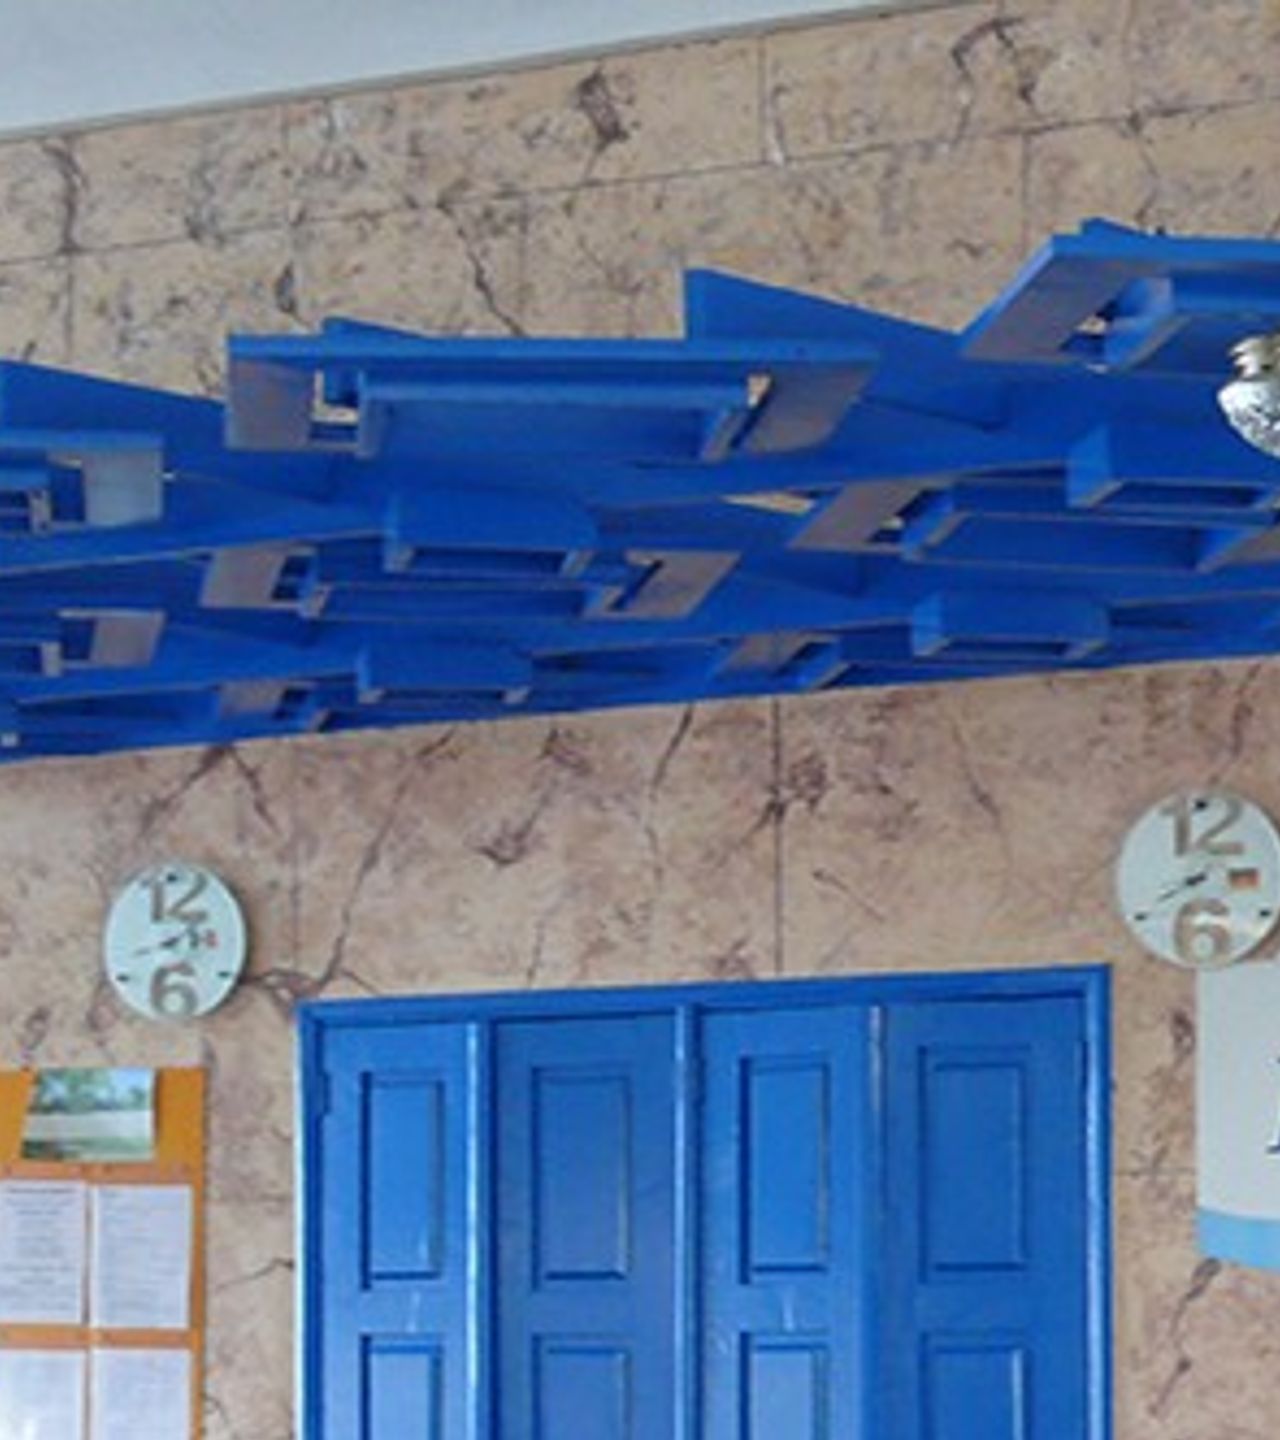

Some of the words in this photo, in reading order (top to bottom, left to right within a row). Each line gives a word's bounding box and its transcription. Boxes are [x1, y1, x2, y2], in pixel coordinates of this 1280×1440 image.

[1159, 796, 1245, 857] 12
[140, 867, 208, 923] 12
[1174, 898, 1233, 967] 6
[150, 961, 200, 1017] 6
